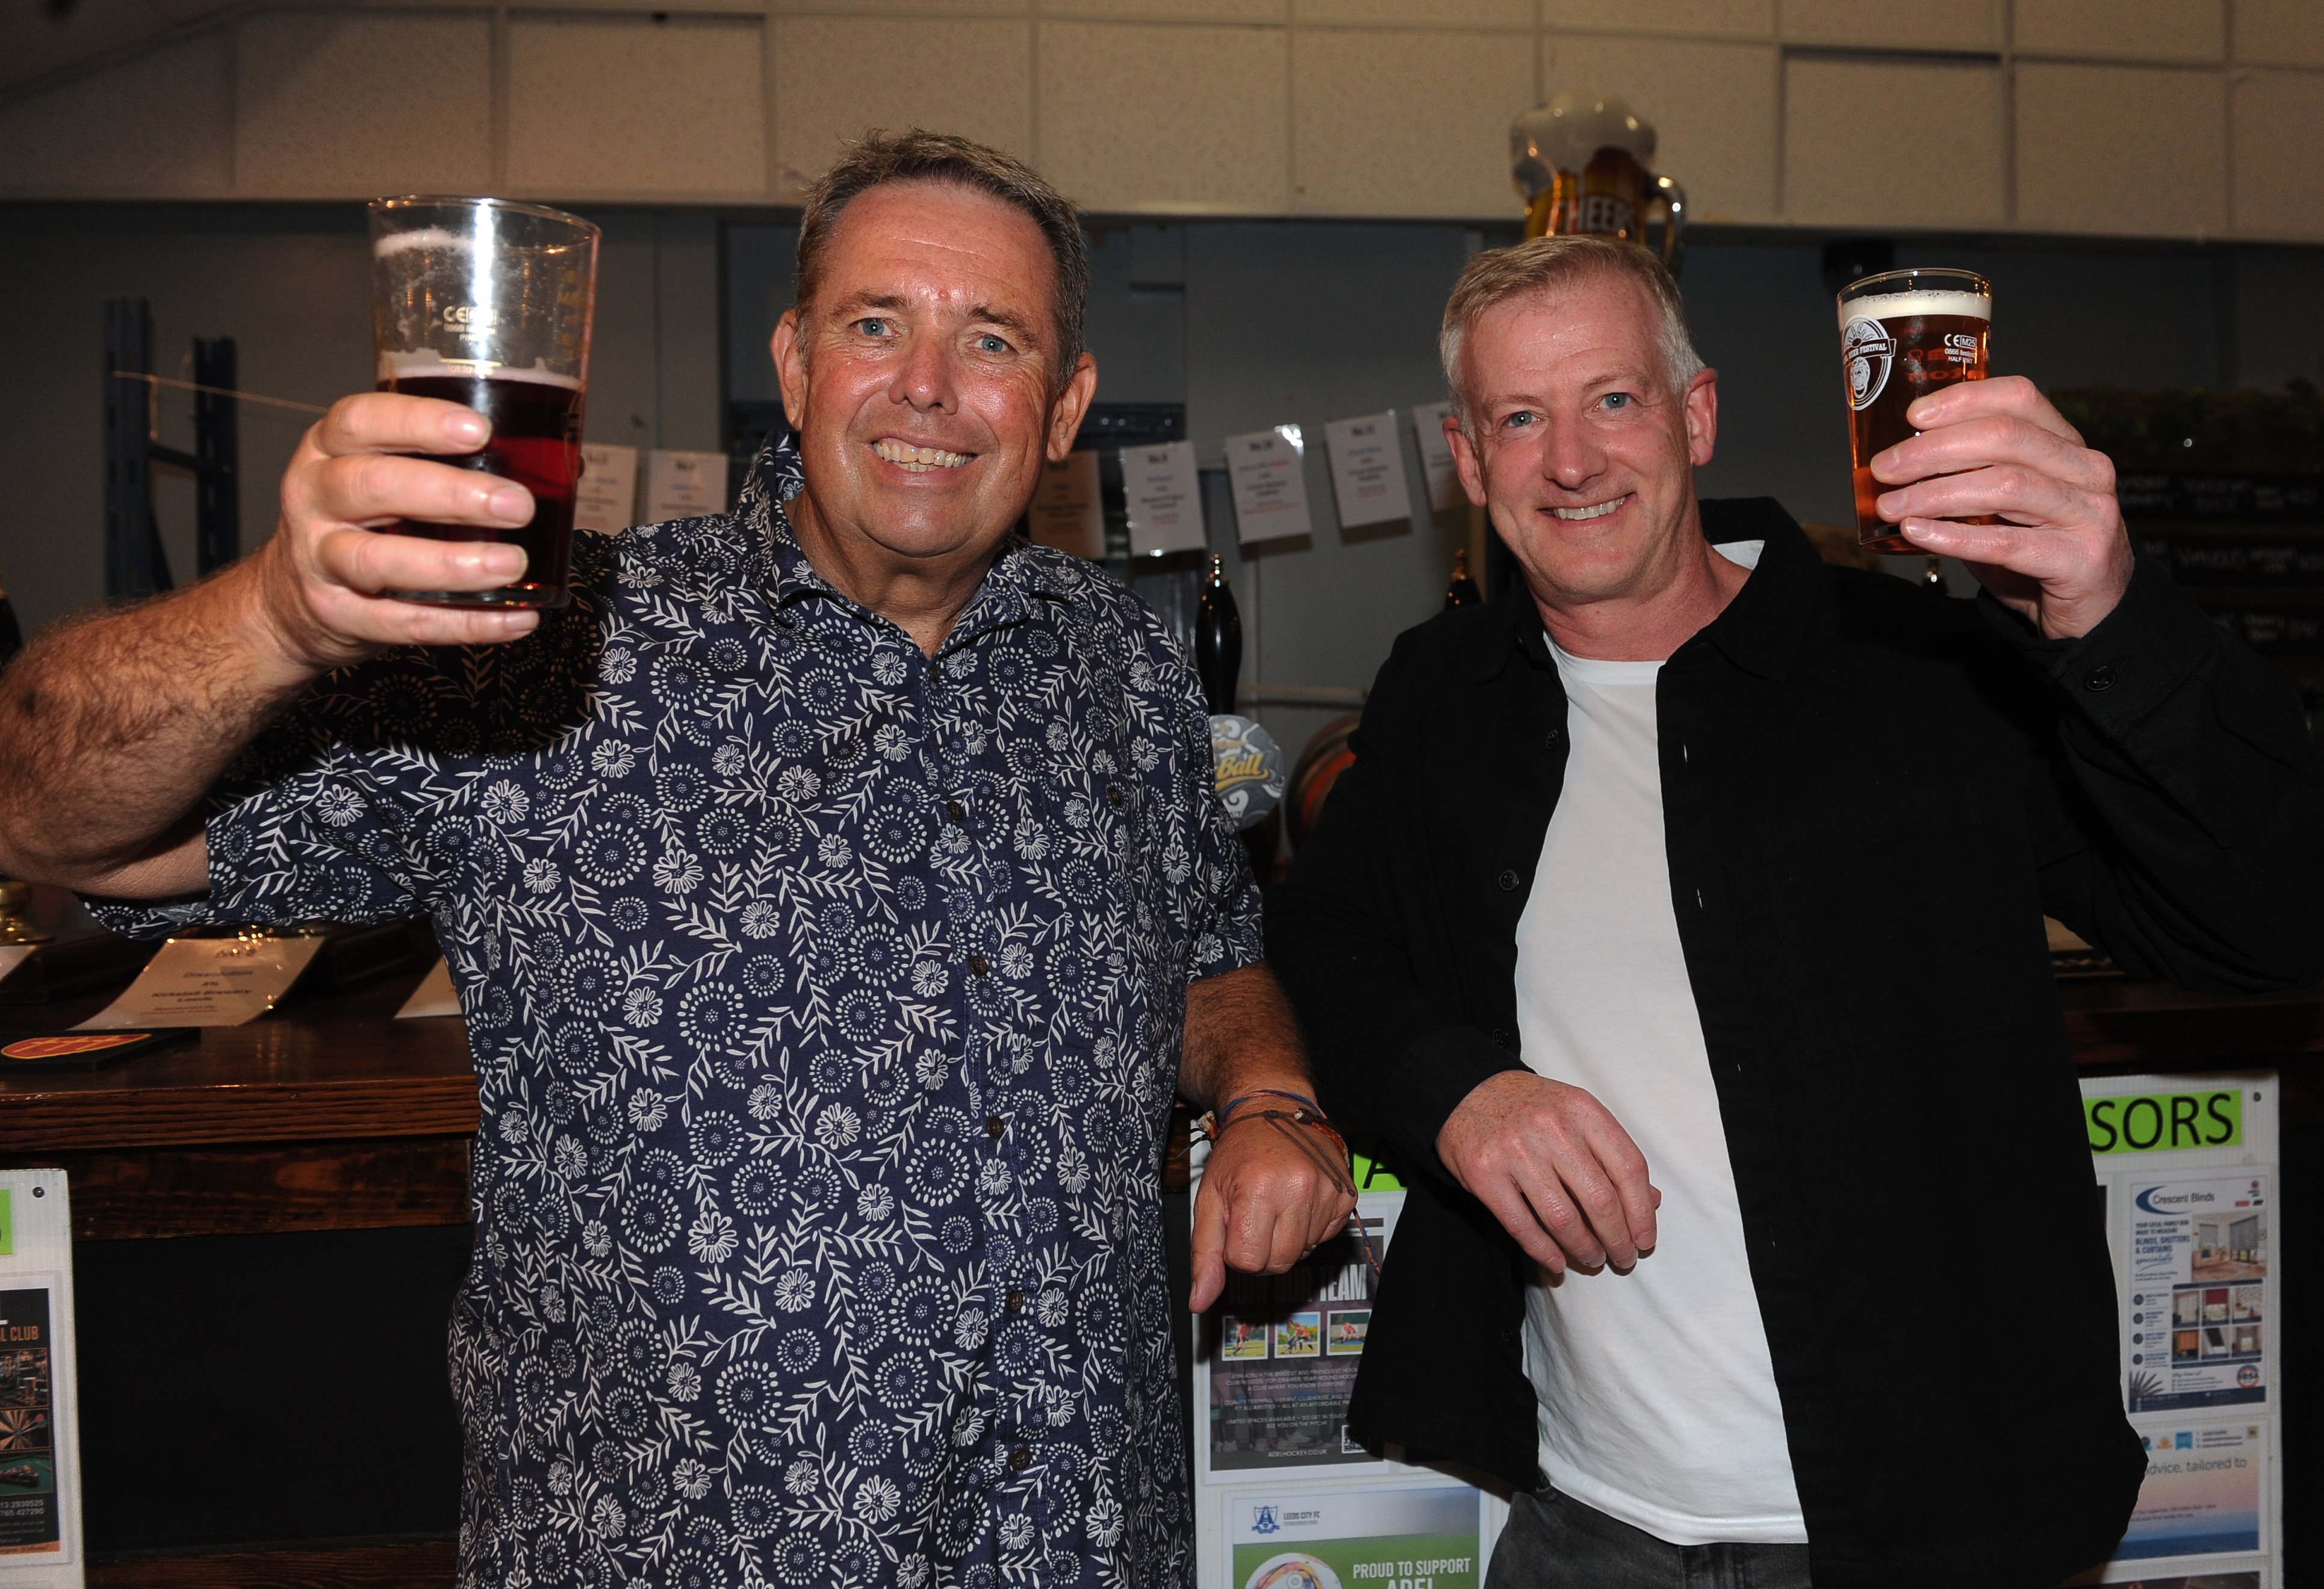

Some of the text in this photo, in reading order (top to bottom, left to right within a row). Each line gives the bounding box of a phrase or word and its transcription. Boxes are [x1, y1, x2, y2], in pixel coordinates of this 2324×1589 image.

[1944, 333, 1975, 347] CE M25
[1859, 342, 1887, 354] FESTIVAL
[2091, 1093, 2234, 1151] SORS
[2154, 1192, 2215, 1205] Crescent Blinds
[2160, 1235, 2190, 1244] SHUTTERS
[1319, 1263, 1367, 1302] TEAM
[10, 1326, 39, 1342] CLUB
[2187, 1458, 2231, 1472] tailored
[2234, 1458, 2247, 1469] to
[1353, 1558, 1471, 1579] PROUD TO SUPPORT
